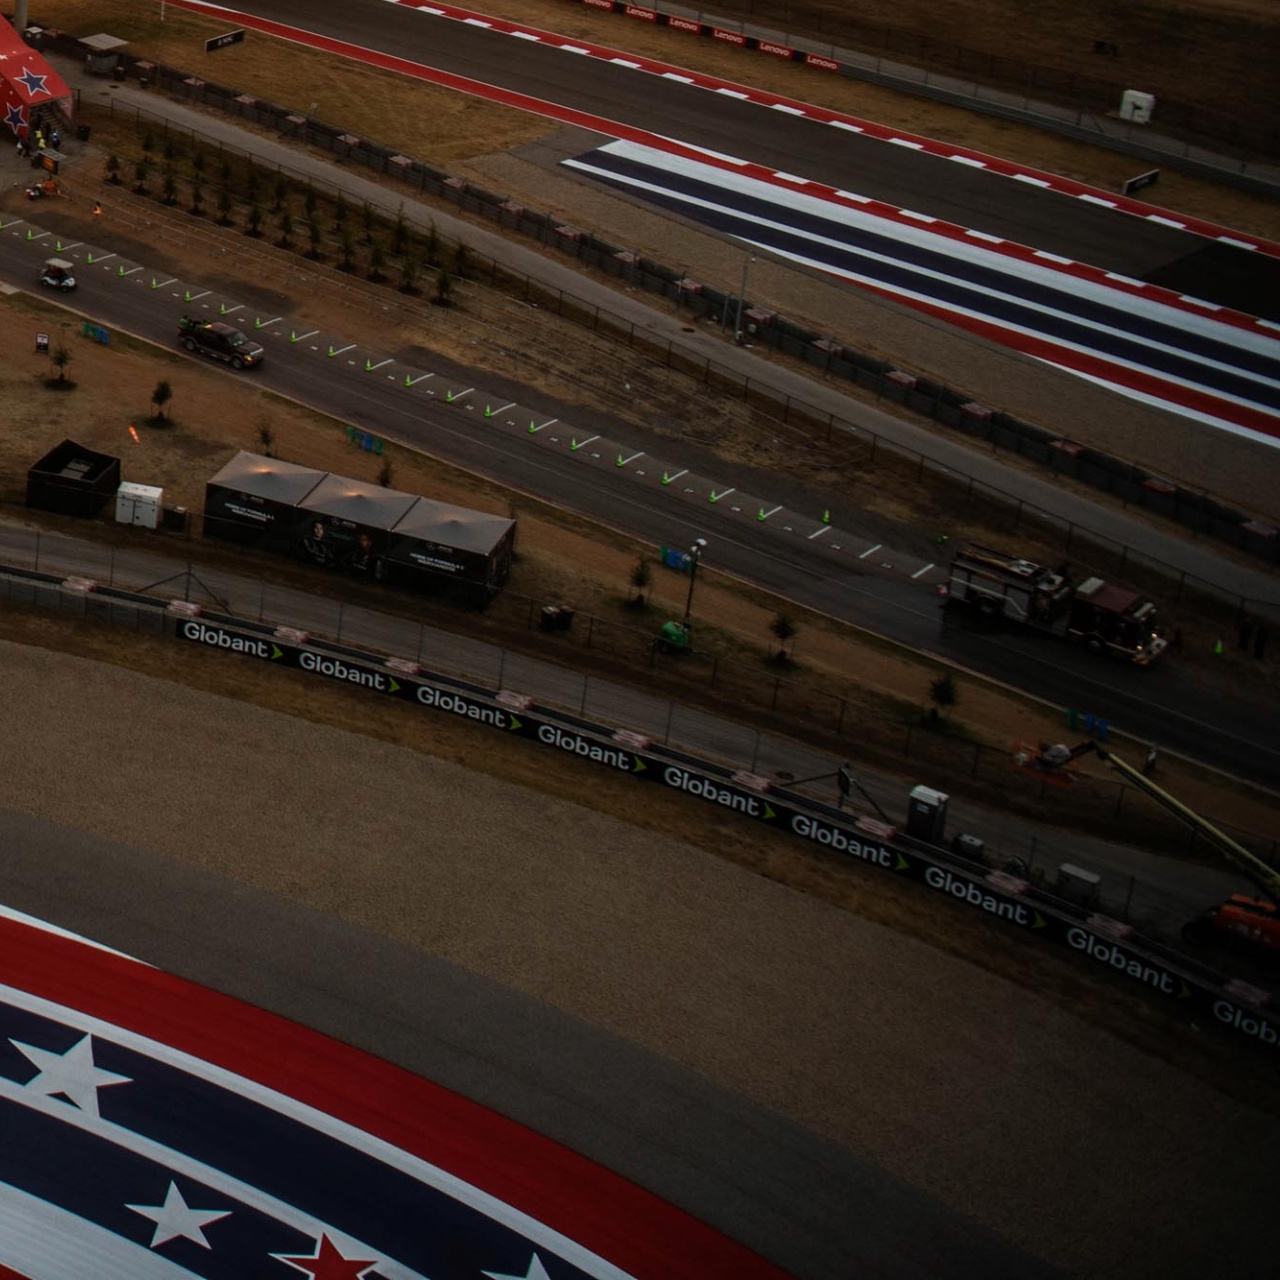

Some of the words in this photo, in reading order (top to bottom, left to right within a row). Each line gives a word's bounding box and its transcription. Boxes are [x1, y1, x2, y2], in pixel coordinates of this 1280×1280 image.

[627, 6, 654, 20] Lenovo
[670, 17, 698, 32] Lenovo
[714, 29, 742, 44] Lenovo
[760, 42, 789, 56] Lenovo
[807, 54, 837, 70] Lenovo
[184, 621, 269, 658] Globant
[299, 652, 385, 690] Globant
[417, 686, 506, 728] Globant
[538, 724, 630, 770] Globant
[664, 767, 759, 817] Globant
[792, 814, 892, 866] Globant
[924, 867, 1028, 925] Globant
[1068, 928, 1174, 994] Globant
[1213, 1001, 1280, 1049] Glob
